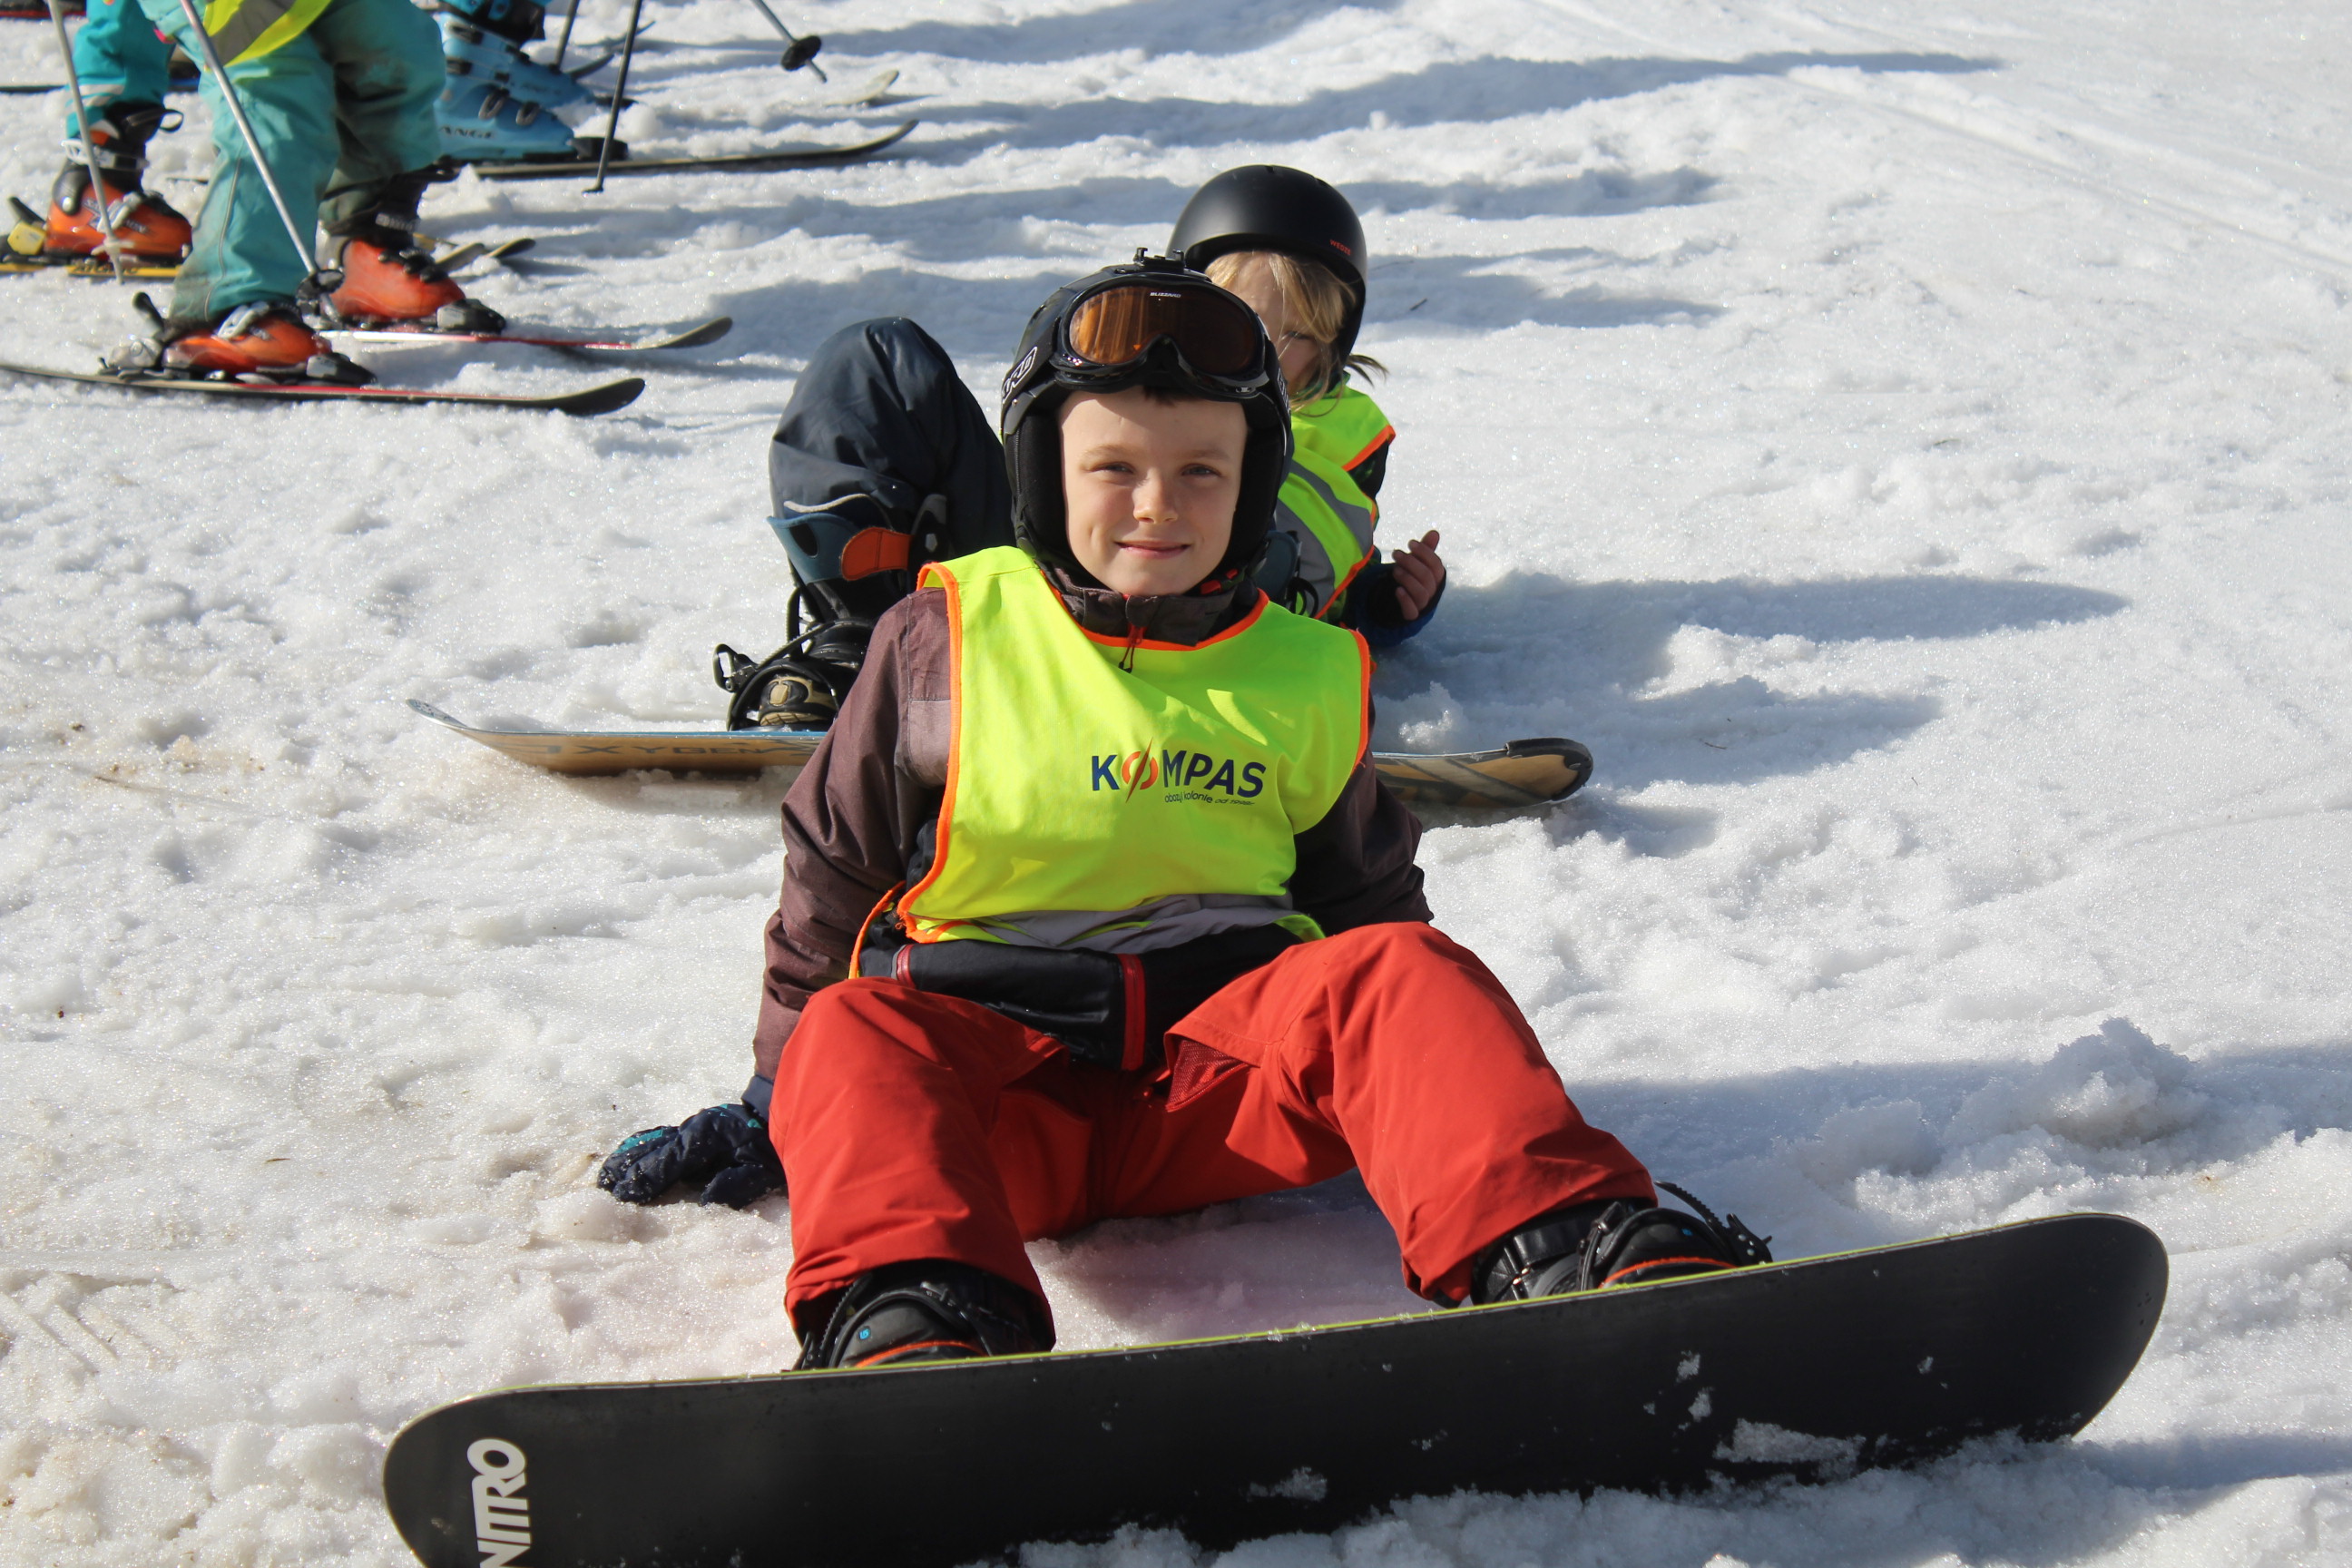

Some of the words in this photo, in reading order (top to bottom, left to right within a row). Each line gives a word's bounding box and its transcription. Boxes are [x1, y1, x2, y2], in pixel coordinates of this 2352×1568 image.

[1092, 741, 1267, 800] KOMPAS
[1183, 790, 1213, 803] kolonie
[466, 1437, 532, 1568] NITRO
